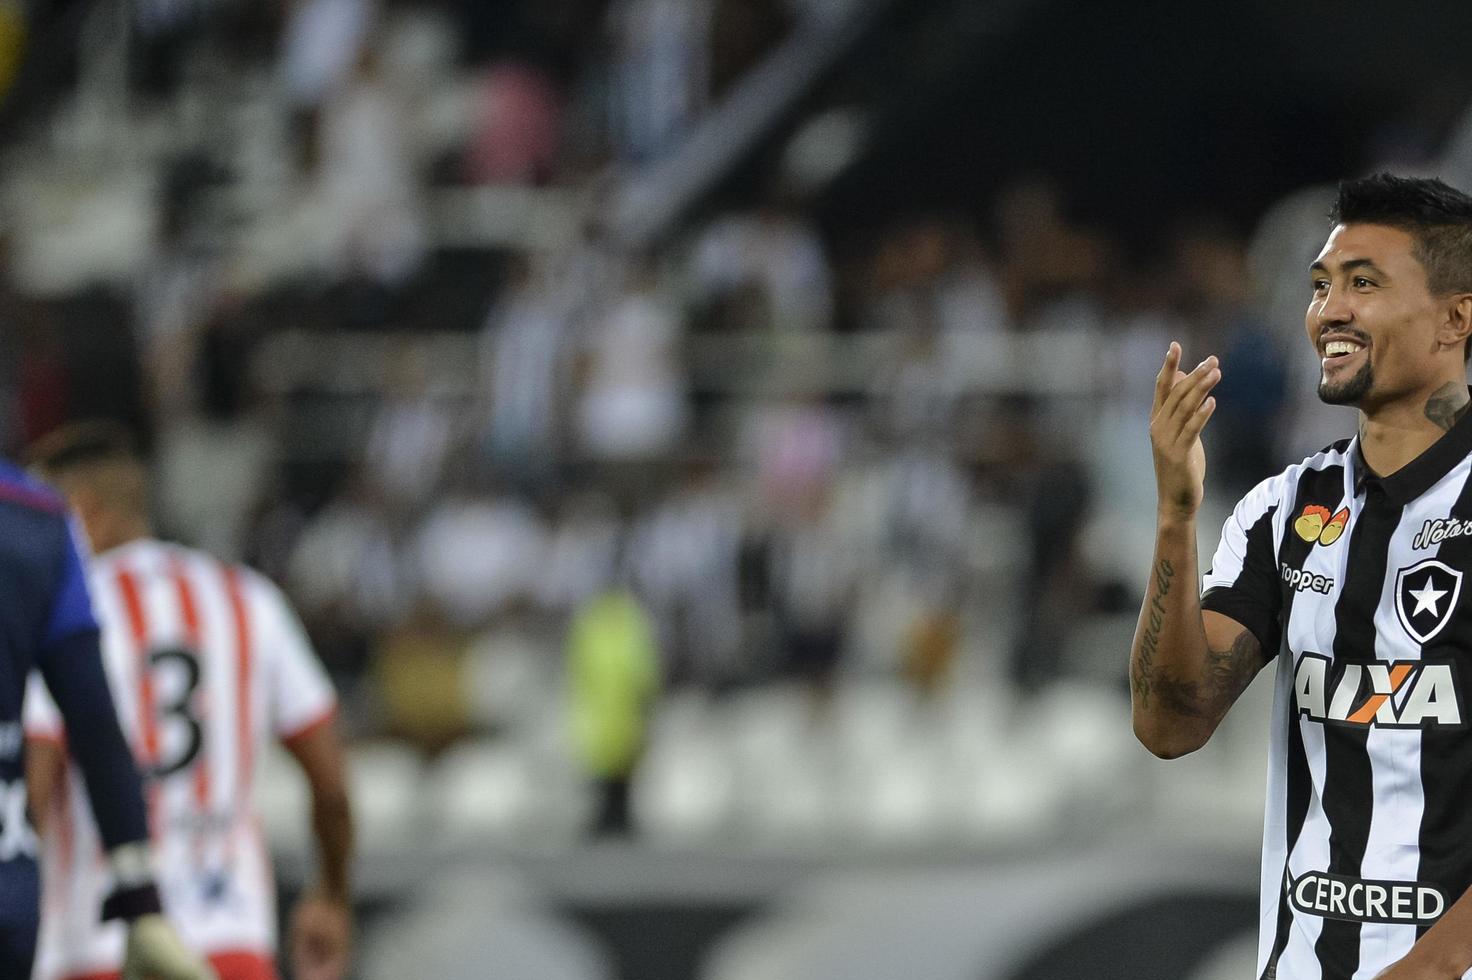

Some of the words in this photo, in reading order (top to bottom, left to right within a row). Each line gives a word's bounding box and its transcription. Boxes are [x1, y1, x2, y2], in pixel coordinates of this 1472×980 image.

[1281, 562, 1335, 594] Topper
[144, 648, 204, 780] 3
[1295, 656, 1462, 725] AIXA
[1295, 875, 1445, 920] CERCRED
